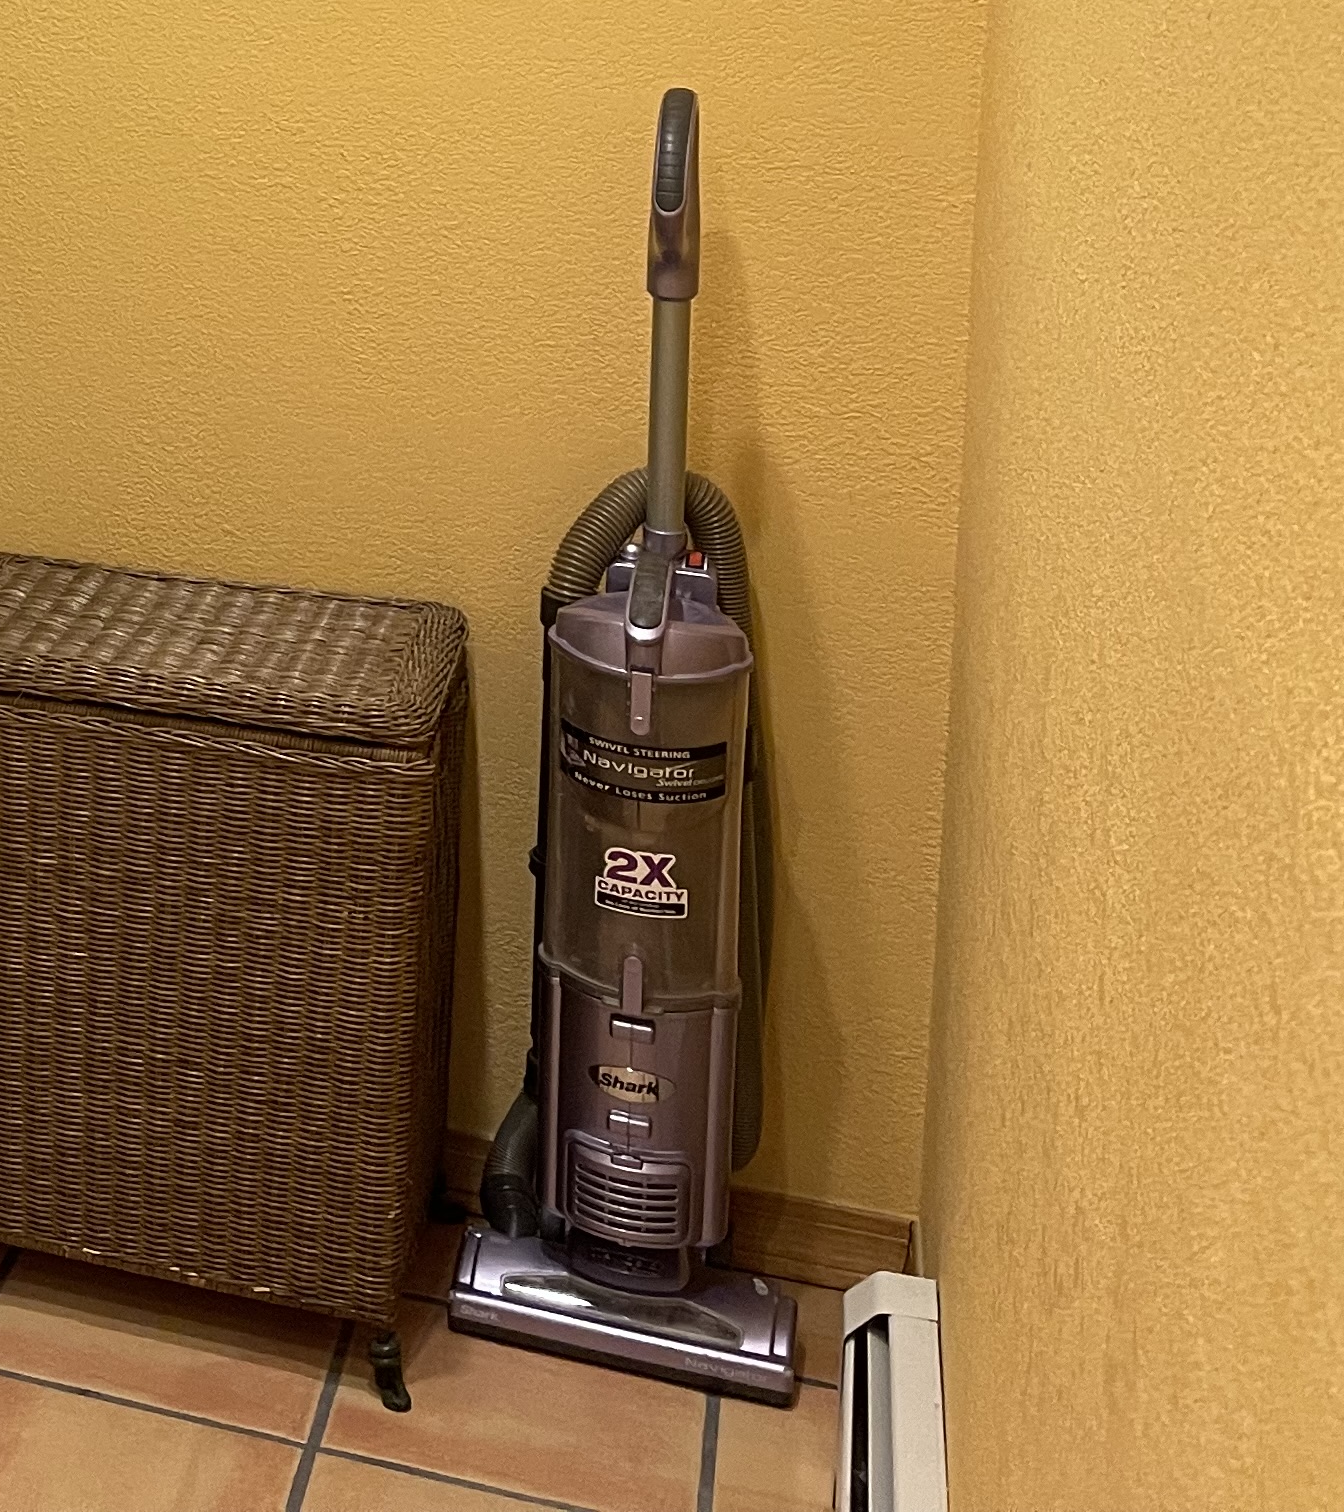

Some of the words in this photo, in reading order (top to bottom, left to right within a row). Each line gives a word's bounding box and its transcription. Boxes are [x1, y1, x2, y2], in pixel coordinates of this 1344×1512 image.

[588, 736, 630, 755] SWIVEL
[633, 747, 691, 760] STEERING
[582, 749, 695, 779] Navigator
[574, 771, 611, 791] Never
[615, 786, 653, 801] Loses
[658, 791, 708, 802] Suction
[607, 850, 674, 889] 2X
[597, 879, 685, 902] CAPACITY
[599, 1072, 659, 1100] Shark
